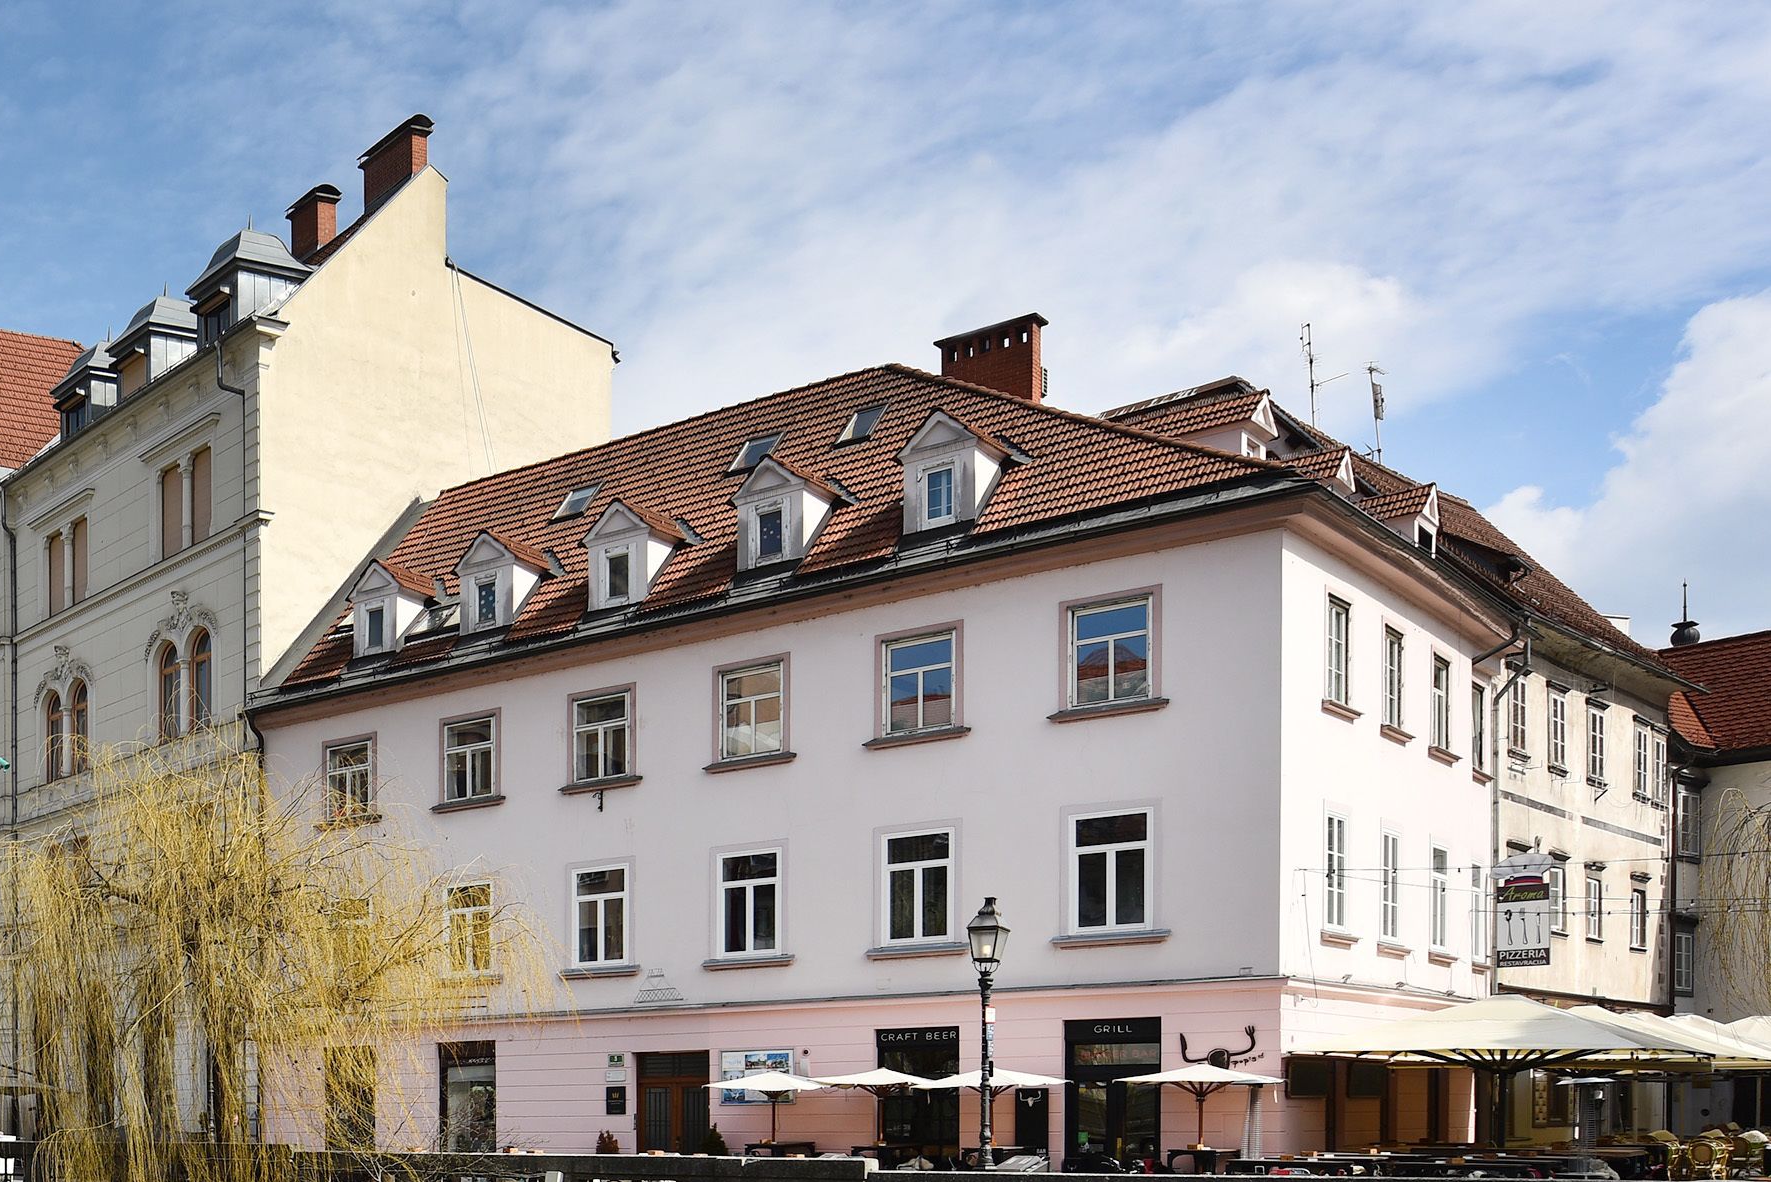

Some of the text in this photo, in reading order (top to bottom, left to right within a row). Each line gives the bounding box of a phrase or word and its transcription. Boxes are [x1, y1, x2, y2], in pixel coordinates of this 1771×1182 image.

[1502, 886, 1544, 901] Aroma
[1499, 949, 1547, 960] PIZZERIA
[1093, 1025, 1132, 1033] GRILL
[880, 1031, 957, 1041] CRAFT BEER
